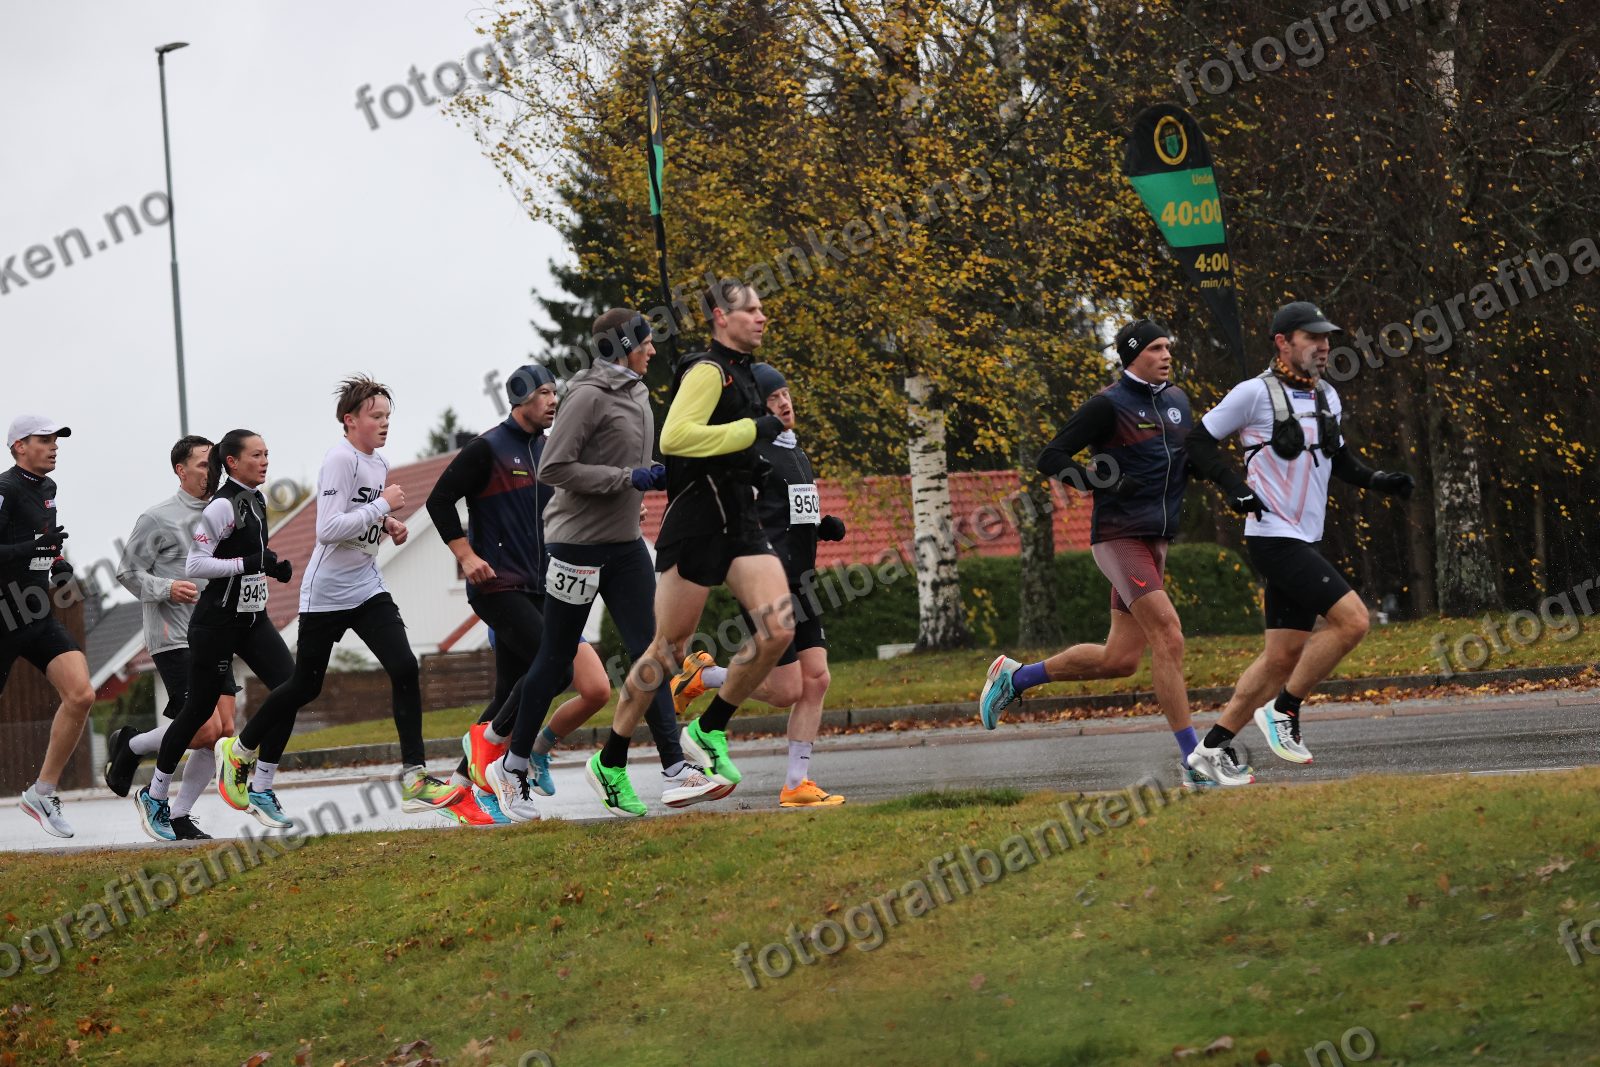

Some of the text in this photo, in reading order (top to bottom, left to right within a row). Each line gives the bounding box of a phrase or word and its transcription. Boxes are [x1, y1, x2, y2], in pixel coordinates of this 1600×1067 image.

[1161, 198, 1222, 227] 40:00
[1194, 252, 1229, 272] 4:00
[1200, 277, 1231, 289] min/k
[794, 494, 819, 514] 950
[554, 572, 587, 596] 371
